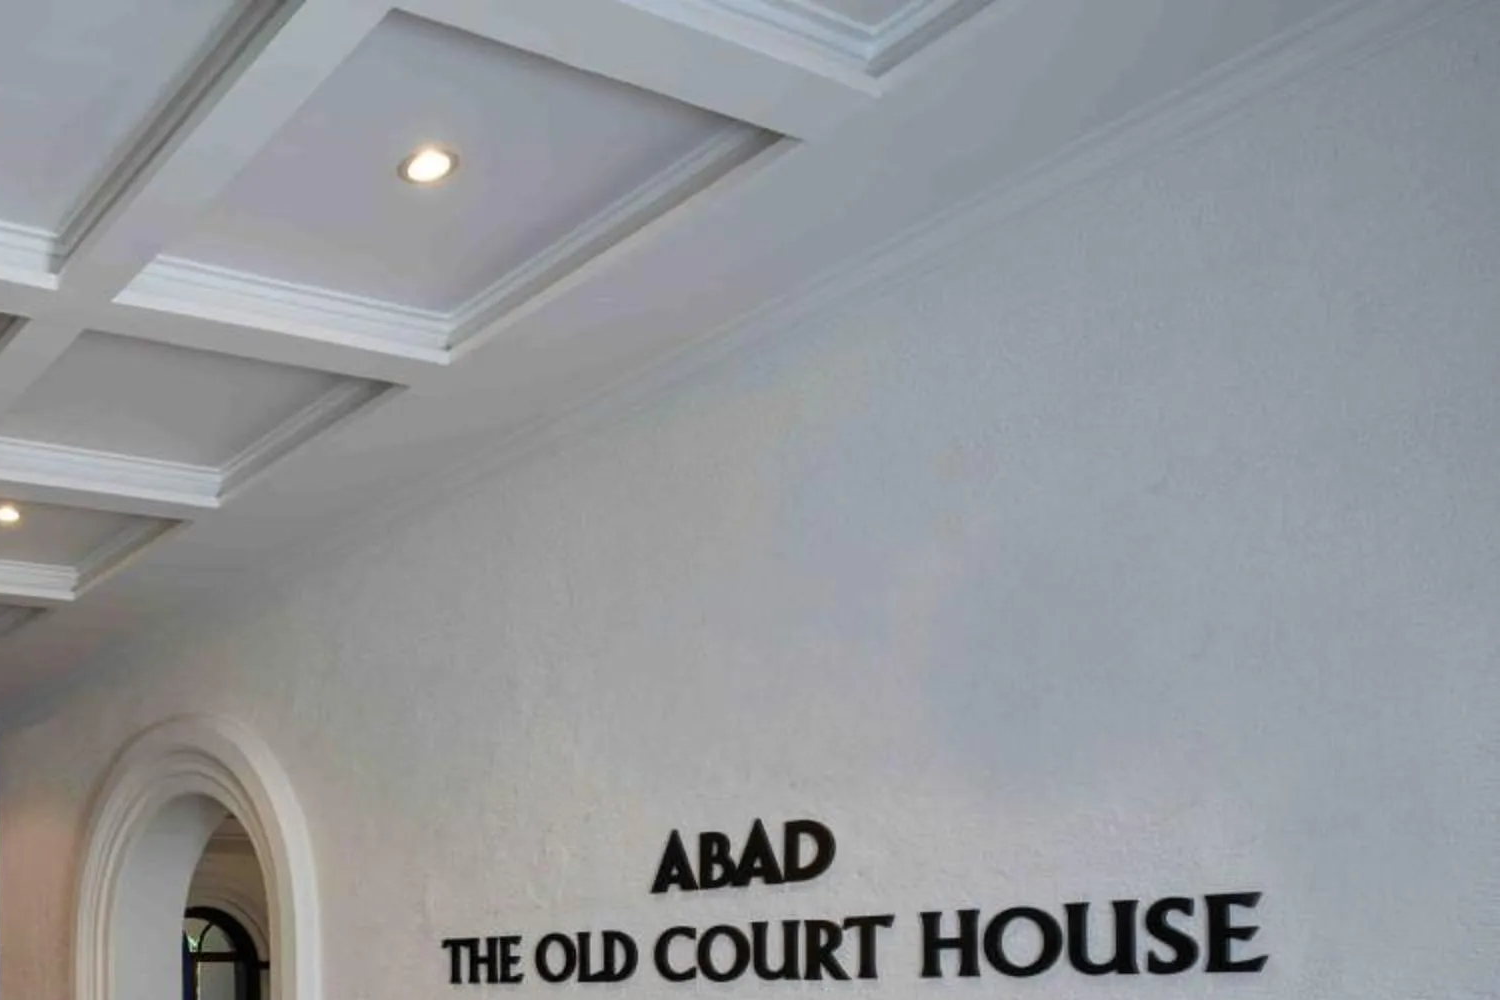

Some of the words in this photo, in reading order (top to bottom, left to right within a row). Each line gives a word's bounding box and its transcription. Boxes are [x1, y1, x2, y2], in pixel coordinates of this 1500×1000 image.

[650, 818, 836, 894] ABAD
[441, 935, 525, 985] THE
[533, 930, 639, 984] OLD
[652, 914, 895, 983] COURT
[919, 891, 1269, 979] HOUSE
